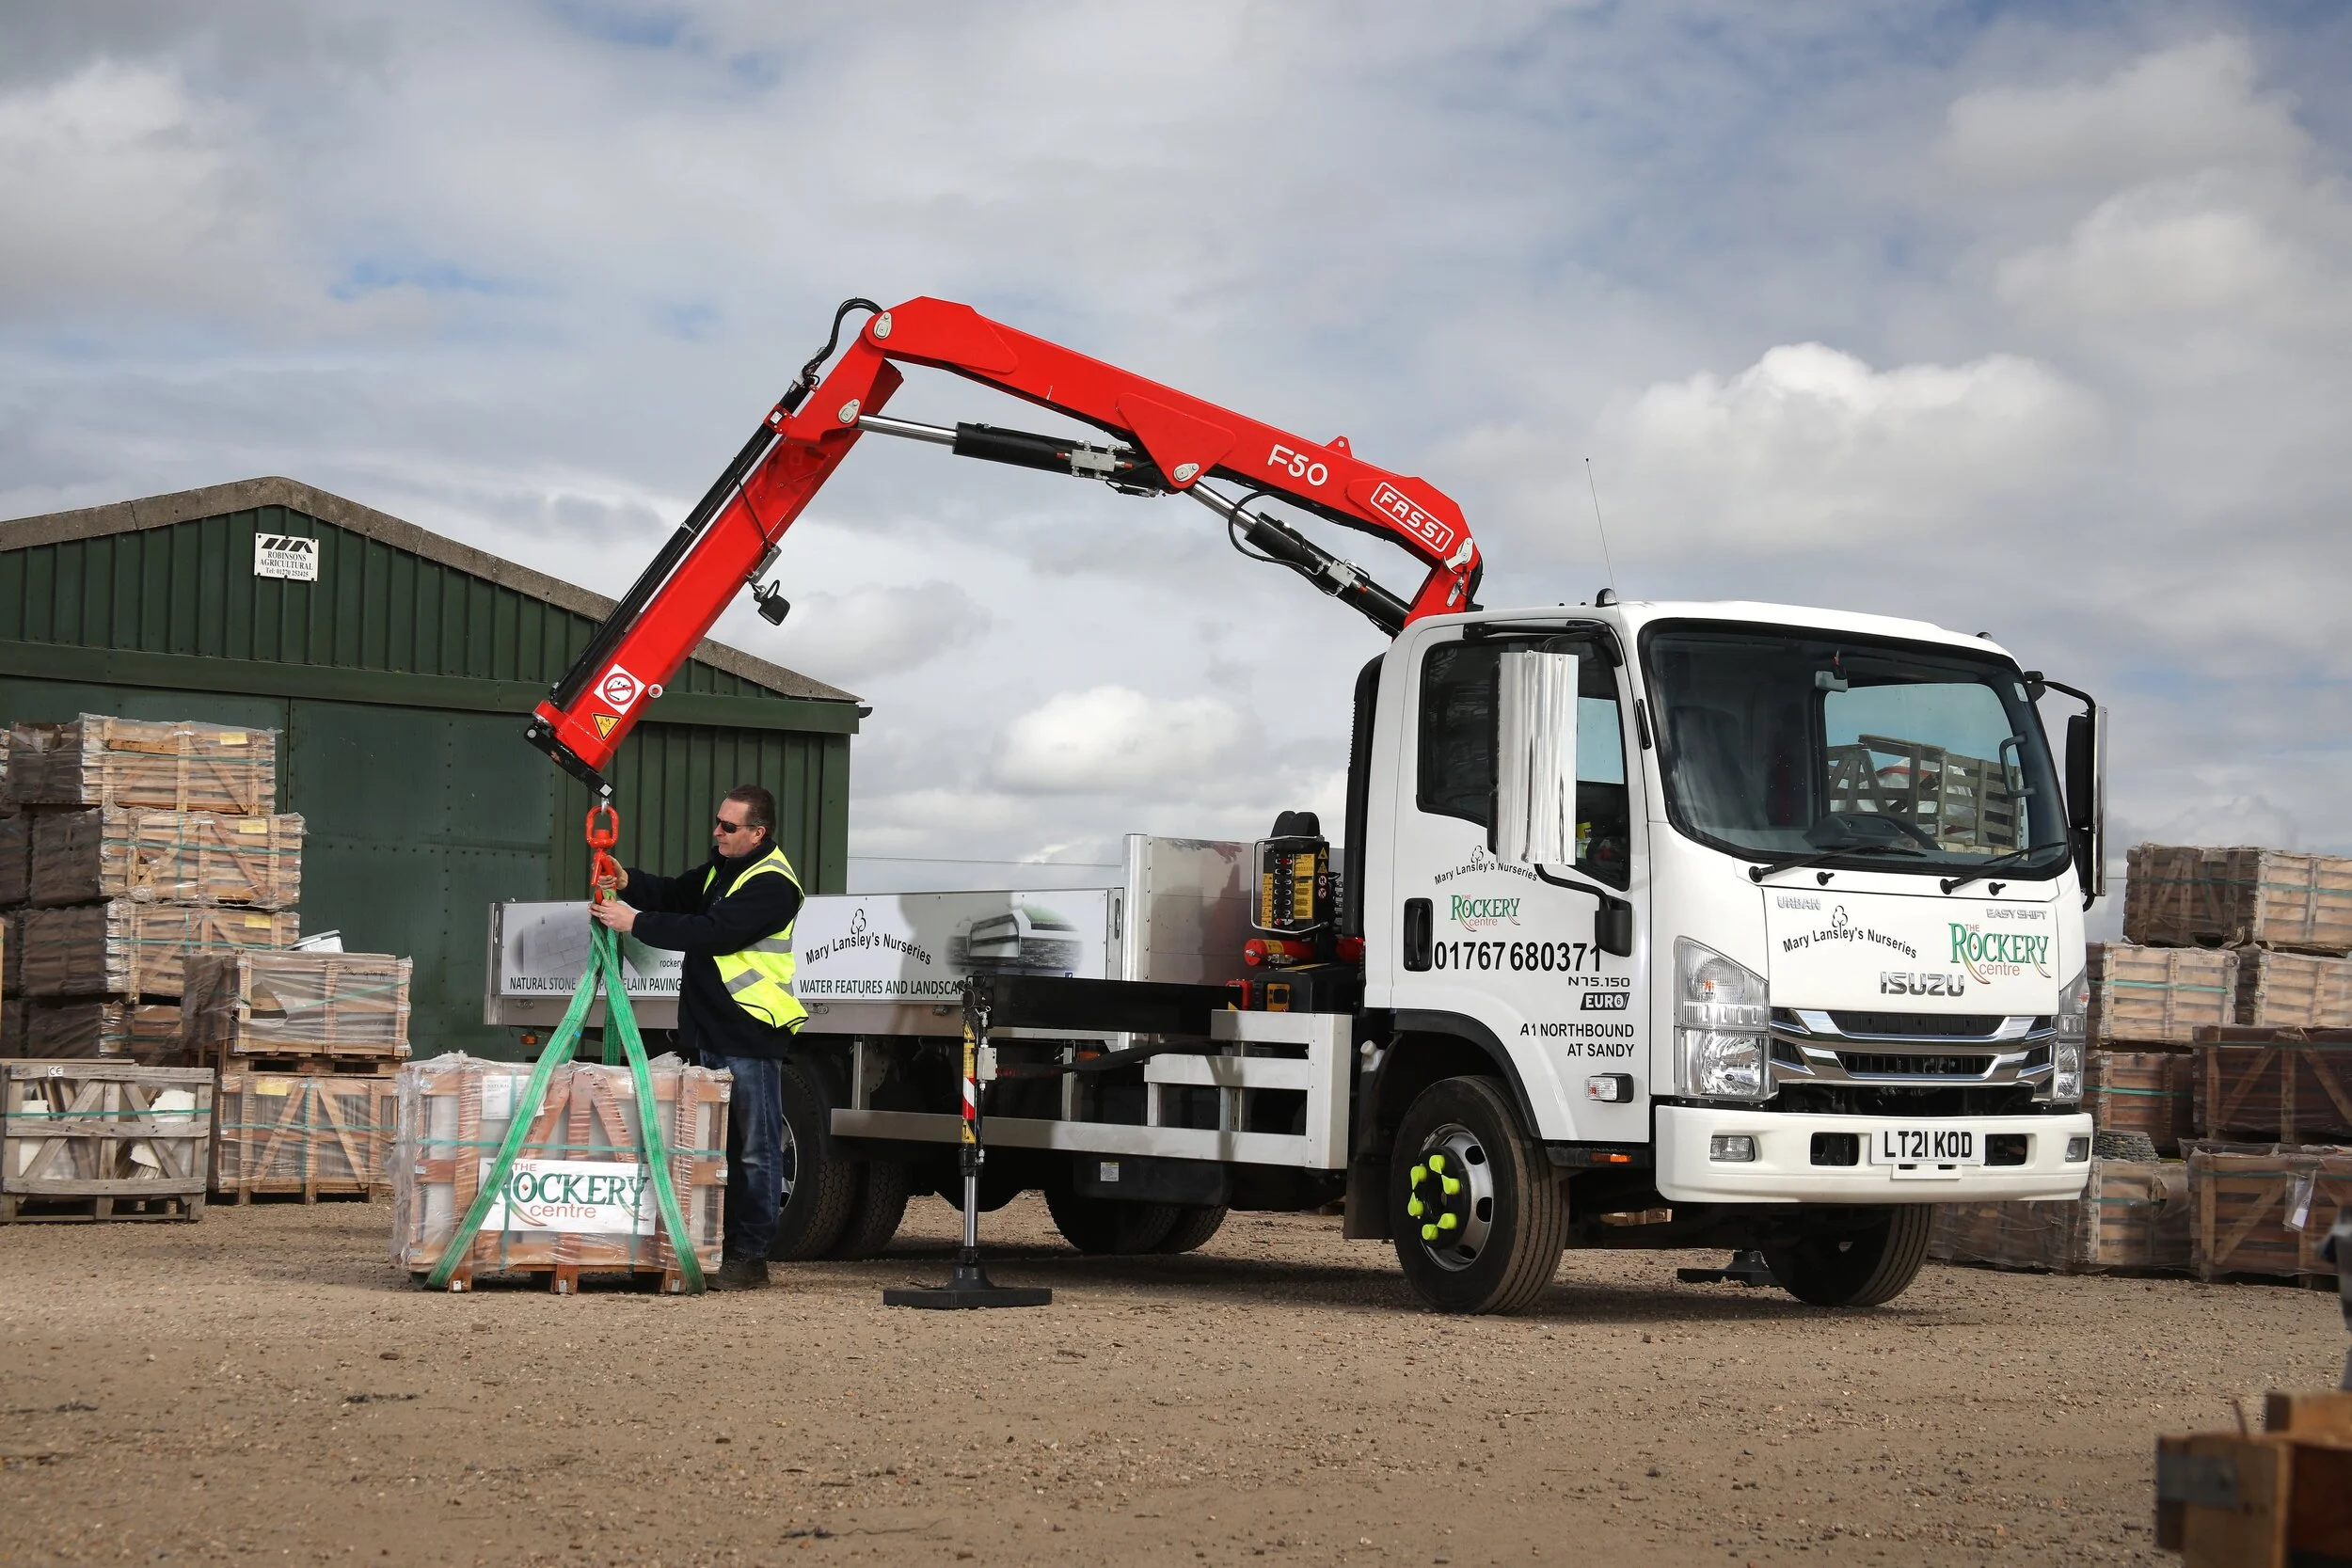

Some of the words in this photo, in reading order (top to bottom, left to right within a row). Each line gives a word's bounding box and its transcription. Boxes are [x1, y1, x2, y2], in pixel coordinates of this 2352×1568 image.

[1267, 444, 1328, 486] F50
[1379, 491, 1445, 544] FASSI
[267, 551, 307, 562] ROBINSONS
[260, 559, 313, 570] AGRICULTURAL
[1434, 870, 1454, 885] Mary
[1456, 861, 1495, 876] Lansley's
[1498, 863, 1538, 881] Nurseries
[1776, 895, 1821, 911] URBAN
[1451, 895, 1520, 931] ROCKERY
[1986, 909, 2016, 919] EASY
[2017, 909, 2047, 920] SHIFT
[1469, 918, 1498, 927] centre
[1964, 924, 1980, 932] THE
[805, 943, 830, 965] Mary
[833, 932, 880, 952] Lansley's
[883, 933, 931, 965] Nurseries
[1783, 934, 1809, 953] Mary
[1812, 927, 1864, 942] Lansley's
[1867, 928, 1917, 958] Nurseries
[1434, 942, 1506, 970] 01767
[1509, 942, 1600, 972] 680371
[1947, 923, 2051, 982] ROCKERY
[1979, 962, 2021, 976] centre
[510, 976, 548, 990] NATURAL
[548, 976, 576, 990] STONE
[649, 976, 682, 991] PAVING
[800, 979, 833, 993] WATER
[834, 979, 882, 994] FEATURES
[885, 980, 908, 994] AND
[1568, 976, 1630, 988] N75.150
[1881, 972, 1964, 997] ISUZU
[1520, 1022, 1536, 1037] A1
[1540, 1023, 1634, 1037] NORTHBOUND
[1567, 1043, 1583, 1057] AT
[1587, 1043, 1635, 1057] SANDY
[49, 1067, 61, 1076] CE
[1884, 1131, 1928, 1158] LT21
[1934, 1131, 1973, 1158] KOD
[514, 1163, 537, 1172] THE
[530, 1203, 596, 1219] centre
